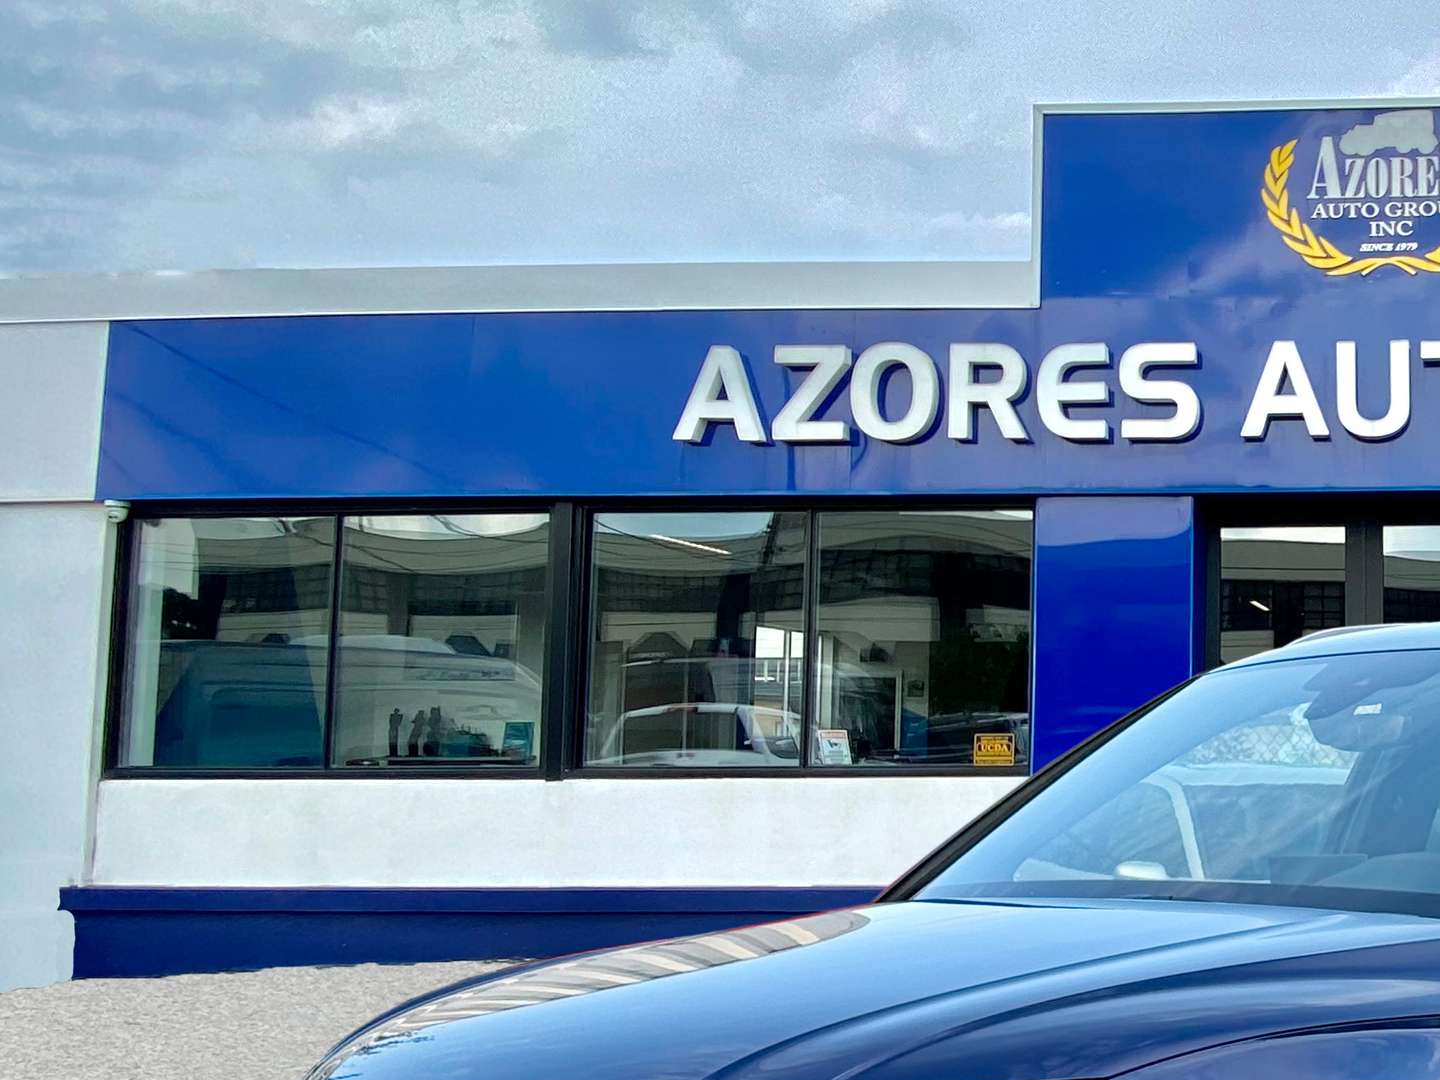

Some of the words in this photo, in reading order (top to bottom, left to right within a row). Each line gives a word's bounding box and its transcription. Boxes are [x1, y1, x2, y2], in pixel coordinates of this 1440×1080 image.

[1311, 202, 1380, 219] AUTO
[1368, 220, 1414, 237] INC
[1359, 243, 1394, 252] SINCE
[1394, 242, 1418, 251] 1979
[673, 341, 1203, 445] AZORES
[980, 743, 1010, 752] UCDA
